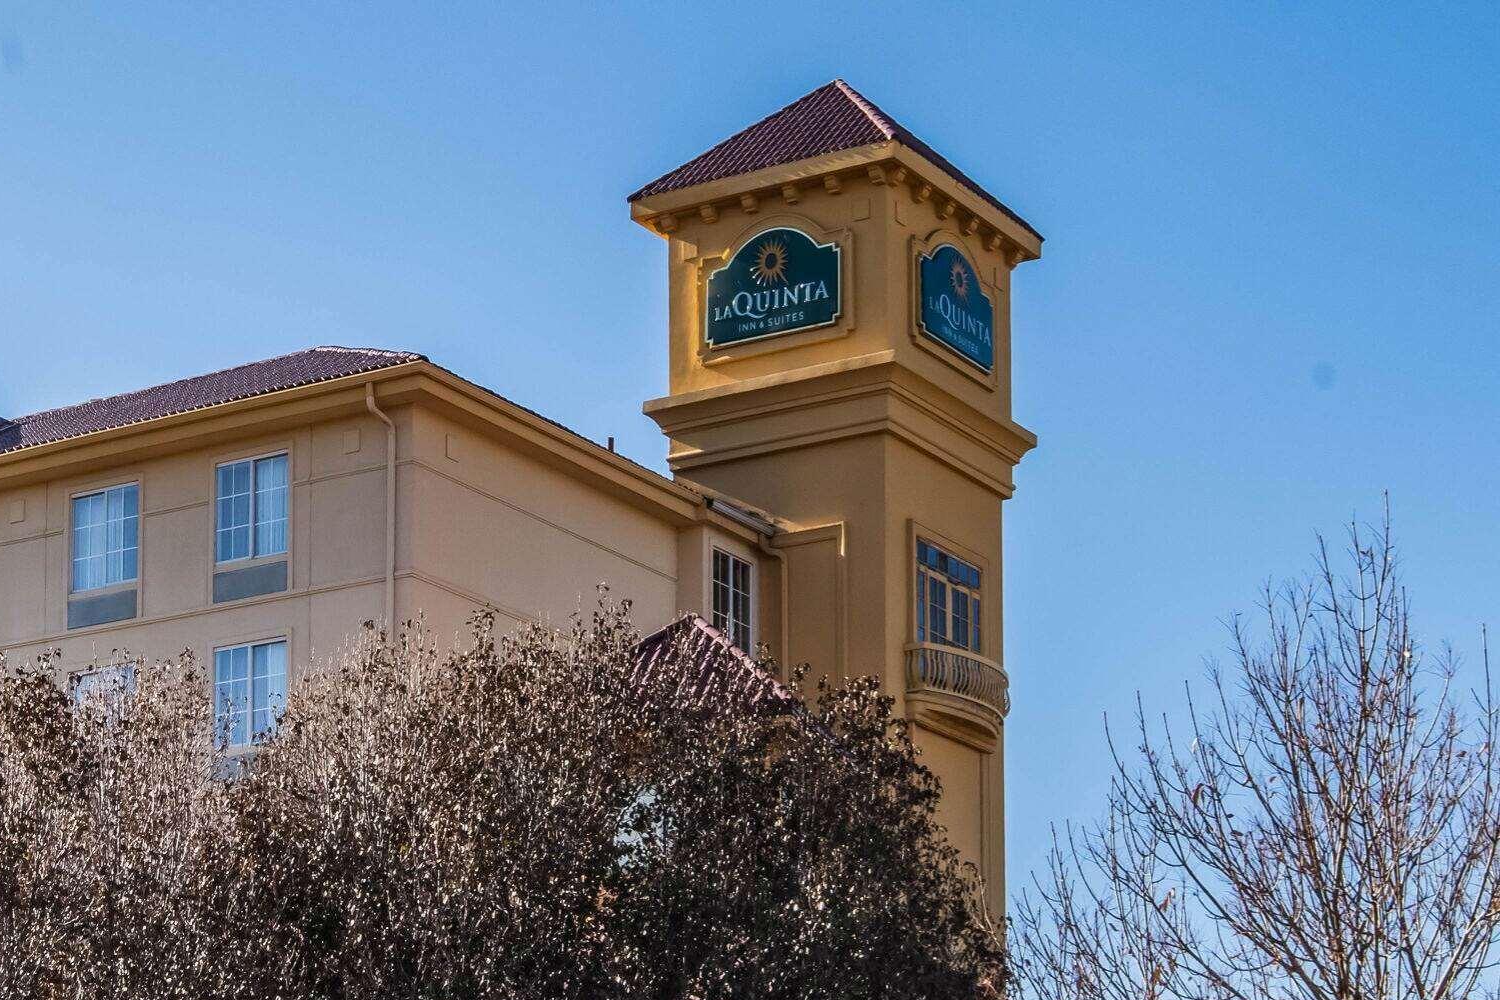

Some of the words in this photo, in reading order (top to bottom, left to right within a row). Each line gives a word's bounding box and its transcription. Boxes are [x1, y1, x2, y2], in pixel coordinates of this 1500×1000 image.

[714, 305, 732, 321] LA
[732, 280, 830, 318] QUINTA
[939, 294, 992, 347] QUINTA
[738, 320, 756, 332] INN
[767, 311, 805, 327] SUITES
